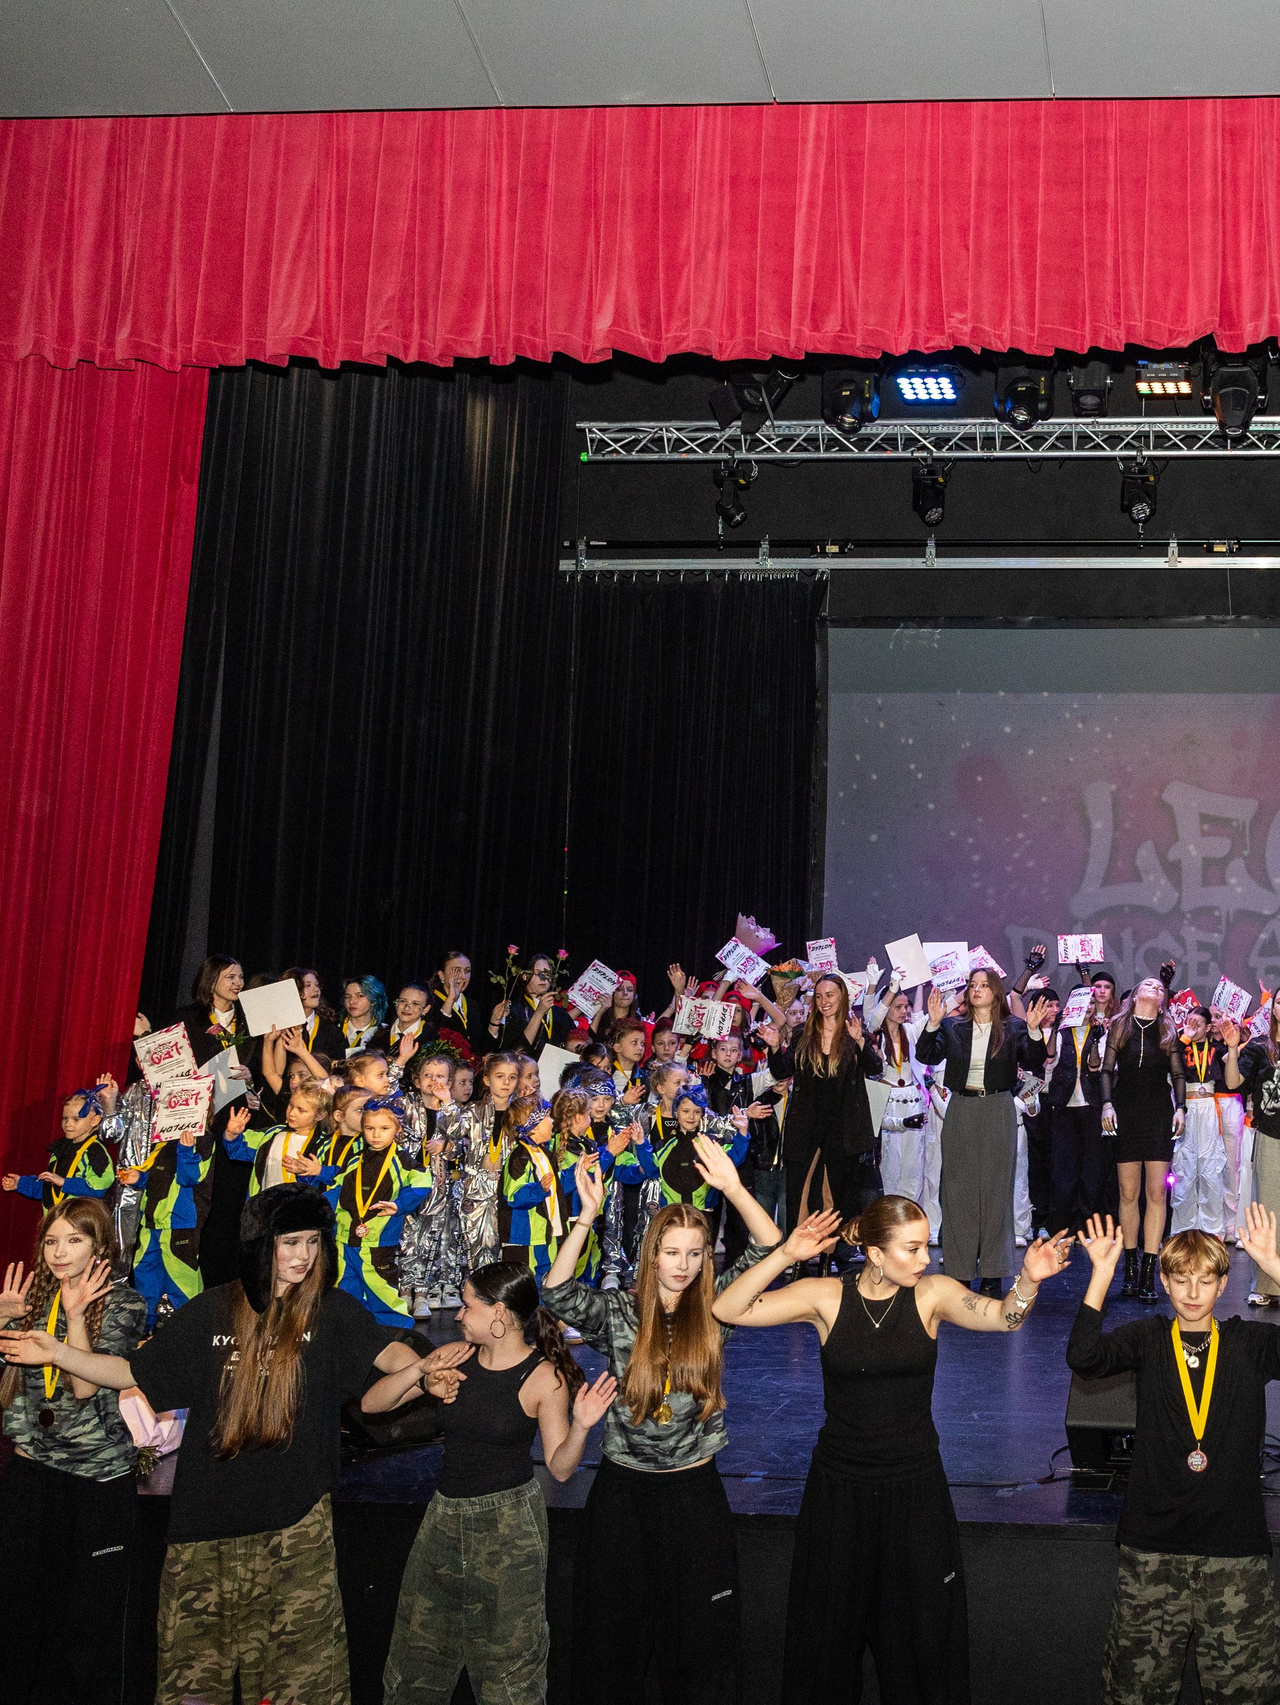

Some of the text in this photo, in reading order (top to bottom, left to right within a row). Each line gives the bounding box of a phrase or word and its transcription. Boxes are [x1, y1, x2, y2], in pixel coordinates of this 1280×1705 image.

[592, 967, 616, 985] DYPLOM
[716, 1006, 728, 1036] DYPLOM
[150, 1042, 181, 1065] LEO
[168, 1091, 201, 1109] LEO
[159, 1121, 200, 1134] DYPLOM
